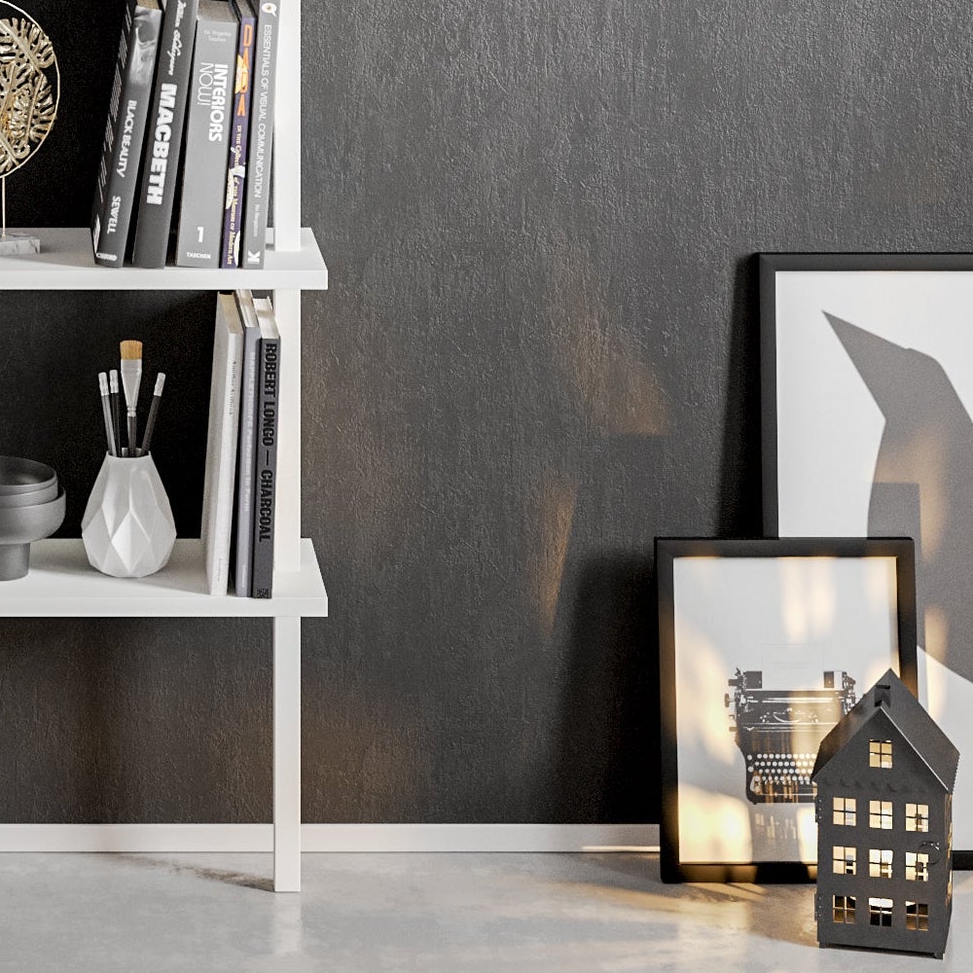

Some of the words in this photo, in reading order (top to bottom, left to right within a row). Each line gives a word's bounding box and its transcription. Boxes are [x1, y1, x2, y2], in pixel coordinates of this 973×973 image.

[260, 24, 273, 77] ESSENTIALS
[196, 62, 214, 107] NOW!
[208, 63, 229, 142] INTERIORS
[260, 77, 269, 92] OF
[124, 100, 137, 134] BLACK
[258, 91, 269, 122] VISUAL
[116, 134, 132, 178] BEAUTY
[146, 83, 178, 206] MACBETH
[253, 123, 268, 199] COMMUNICATION
[106, 195, 122, 235] SEWELL
[230, 198, 239, 223] Museum
[186, 251, 211, 260] TASCHEN
[196, 226, 205, 243] 1
[228, 230, 237, 255] Modern
[226, 254, 235, 265] Art
[247, 250, 261, 265] K
[247, 351, 256, 428] MAPPLETHORPE
[263, 343, 277, 398] ROBERT
[262, 401, 276, 447] LONGO
[244, 429, 253, 476] Perfection
[243, 487, 251, 513] Form
[259, 469, 274, 543] CHARCOAL
